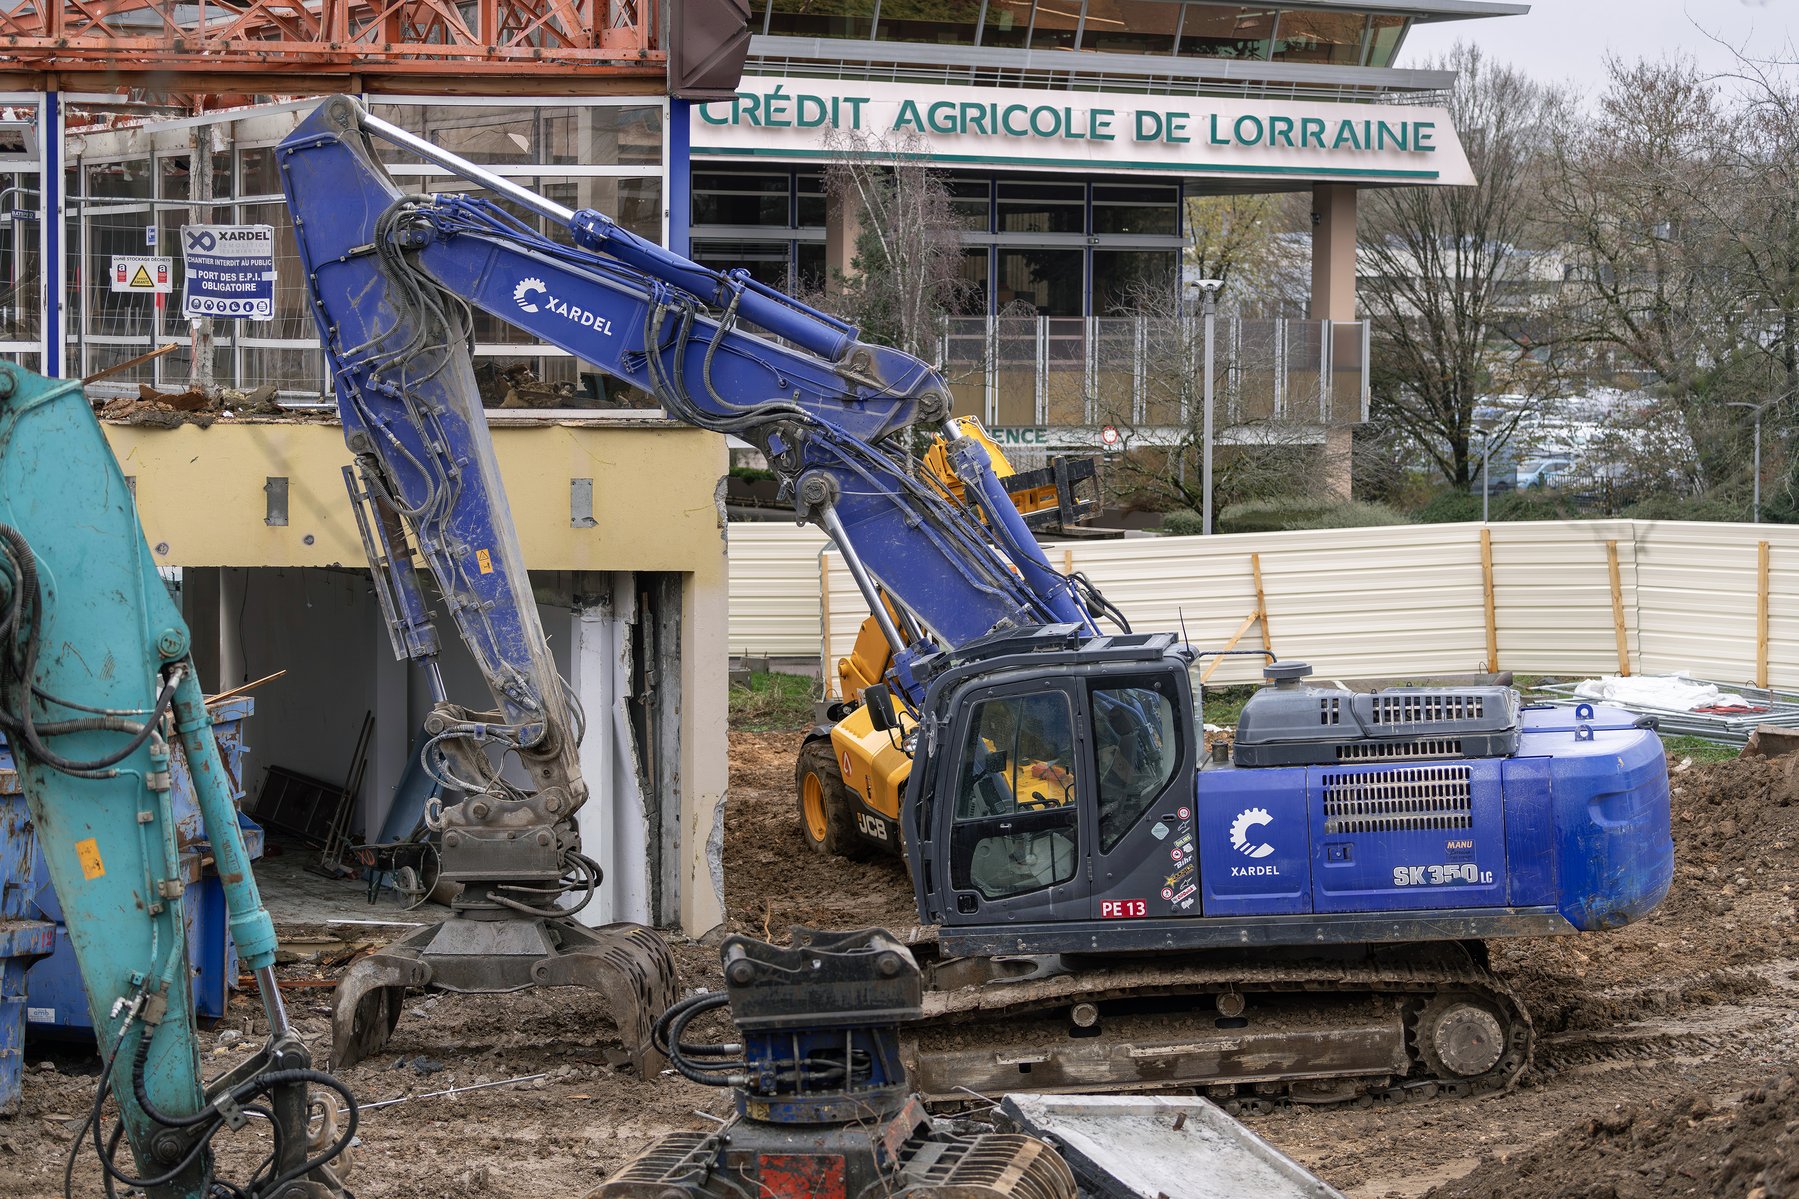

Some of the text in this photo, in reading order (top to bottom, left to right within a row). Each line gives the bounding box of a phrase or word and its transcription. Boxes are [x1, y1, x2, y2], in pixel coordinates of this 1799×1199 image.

[700, 84, 1437, 152] CRÉDIT AGRICOLE DE LORRAINE
[218, 231, 270, 241] XARDEL
[187, 256, 214, 265] CHANTIER
[215, 258, 240, 267] INTERDIT
[198, 270, 261, 281] PORT DES E.P.I.
[202, 281, 257, 292] OBLIGATOIRE
[544, 296, 613, 336] XARDEL
[988, 428, 1048, 444] ENCE
[857, 812, 888, 841] JCB
[1446, 840, 1473, 849] MANU
[1230, 865, 1280, 877] XARDEL
[1480, 871, 1493, 884] LC
[1102, 901, 1146, 917] PE 13
